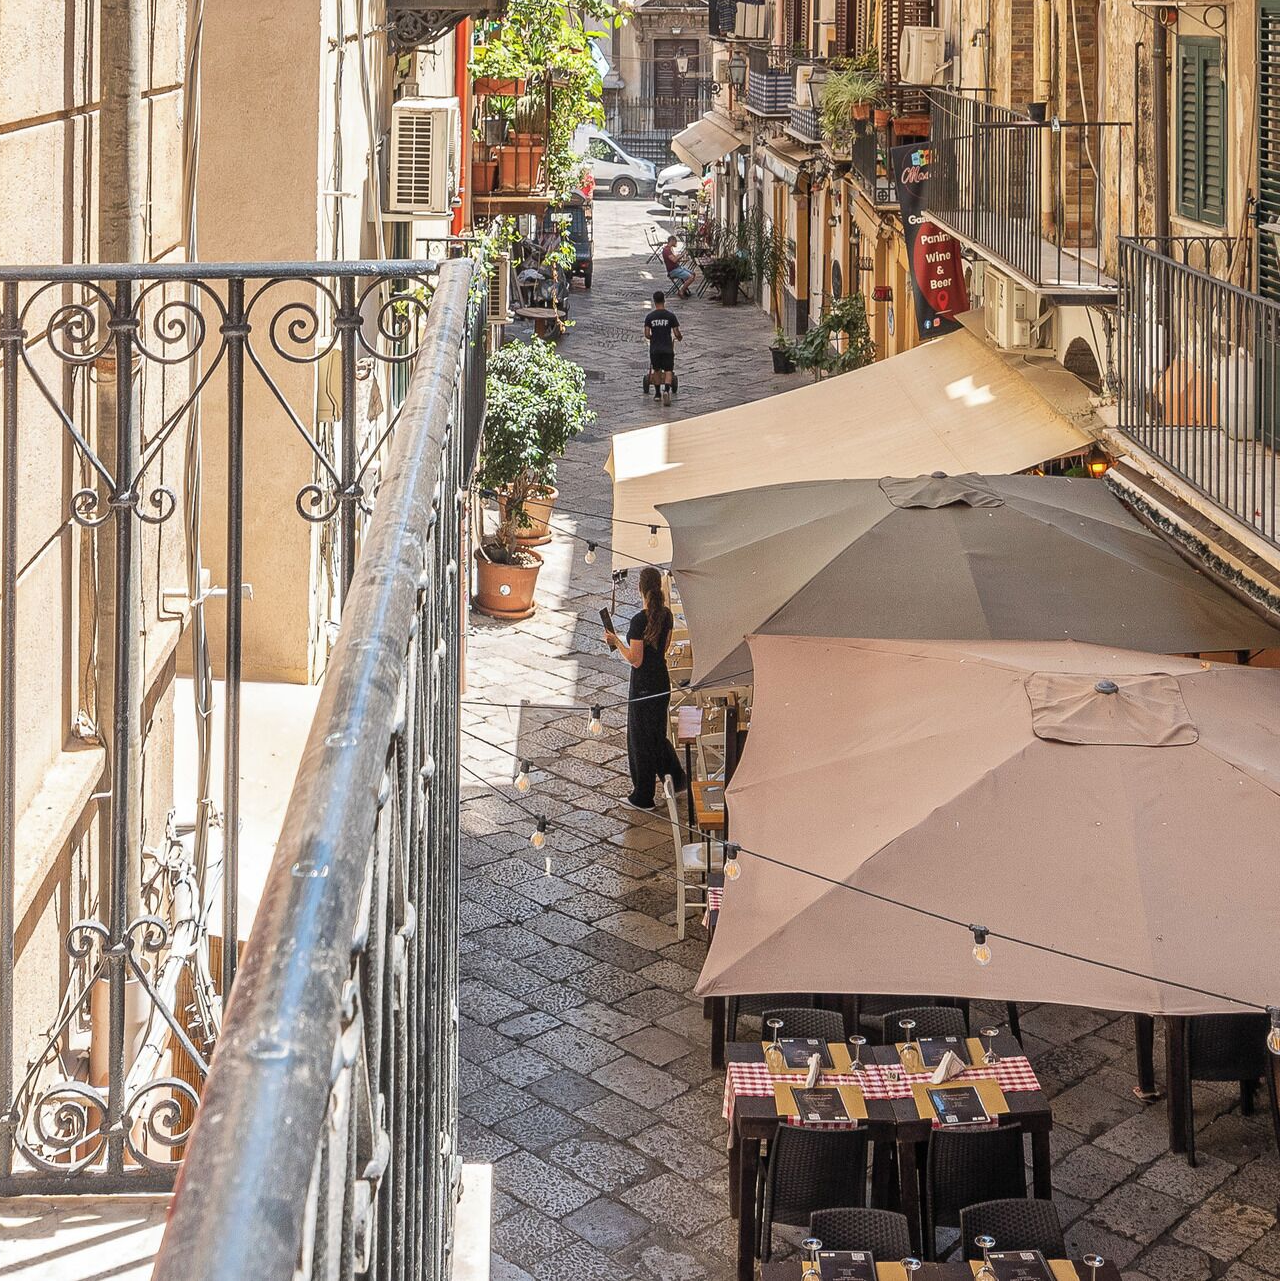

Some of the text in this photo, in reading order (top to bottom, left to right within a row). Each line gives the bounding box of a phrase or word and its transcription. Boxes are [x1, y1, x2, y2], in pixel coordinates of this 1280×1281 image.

[920, 232, 950, 245] Panin
[926, 251, 951, 263] Wine
[936, 266, 944, 275] &
[930, 278, 952, 290] Beer
[651, 319, 669, 327] STAFF
